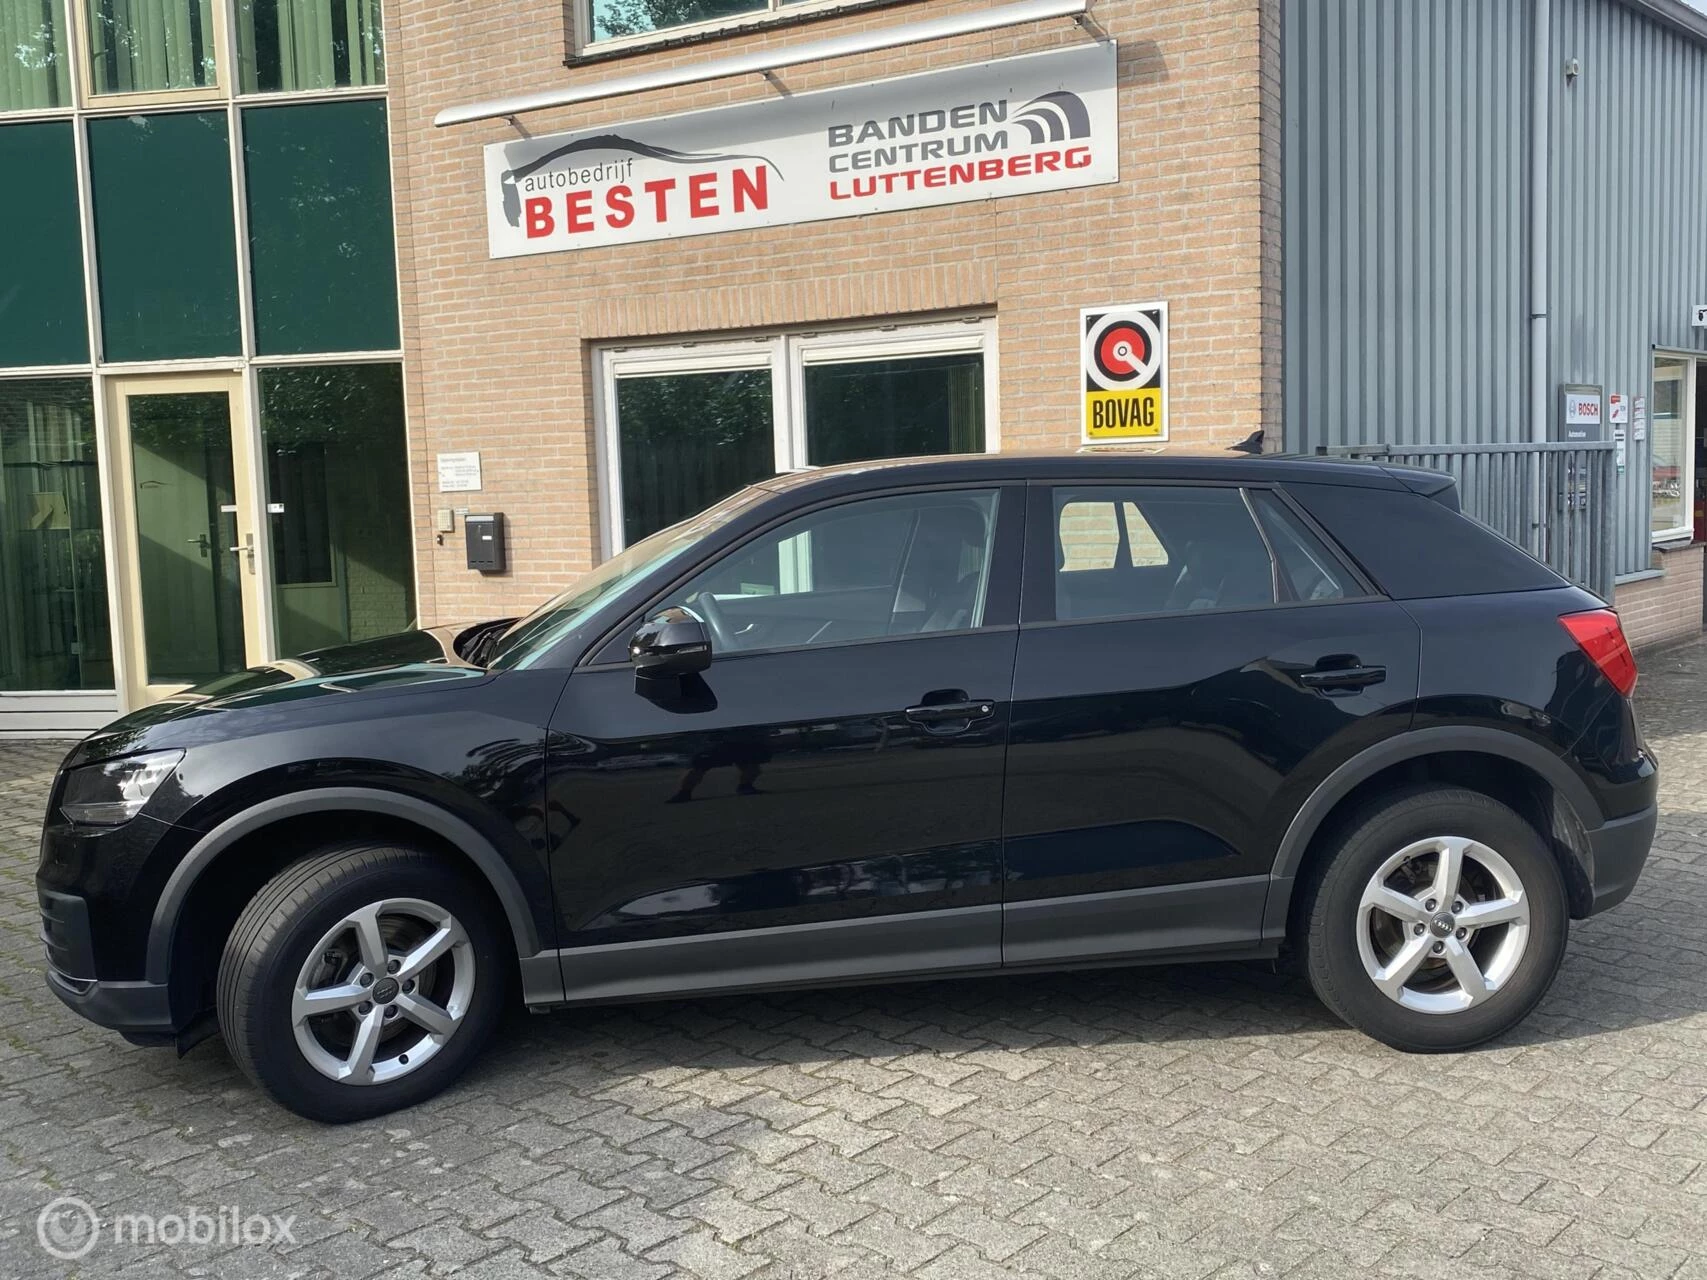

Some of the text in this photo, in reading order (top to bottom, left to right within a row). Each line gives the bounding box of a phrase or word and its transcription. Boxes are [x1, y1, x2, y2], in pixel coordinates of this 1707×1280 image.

[828, 100, 1007, 148] BANDEN
[829, 130, 1008, 173] CENTRUM
[830, 146, 1092, 200] LUTTENBERG
[525, 158, 633, 192] autobedrijf
[525, 165, 768, 239] BESTEN
[1093, 397, 1154, 428] BOVAG
[1578, 403, 1599, 416] BOSCH
